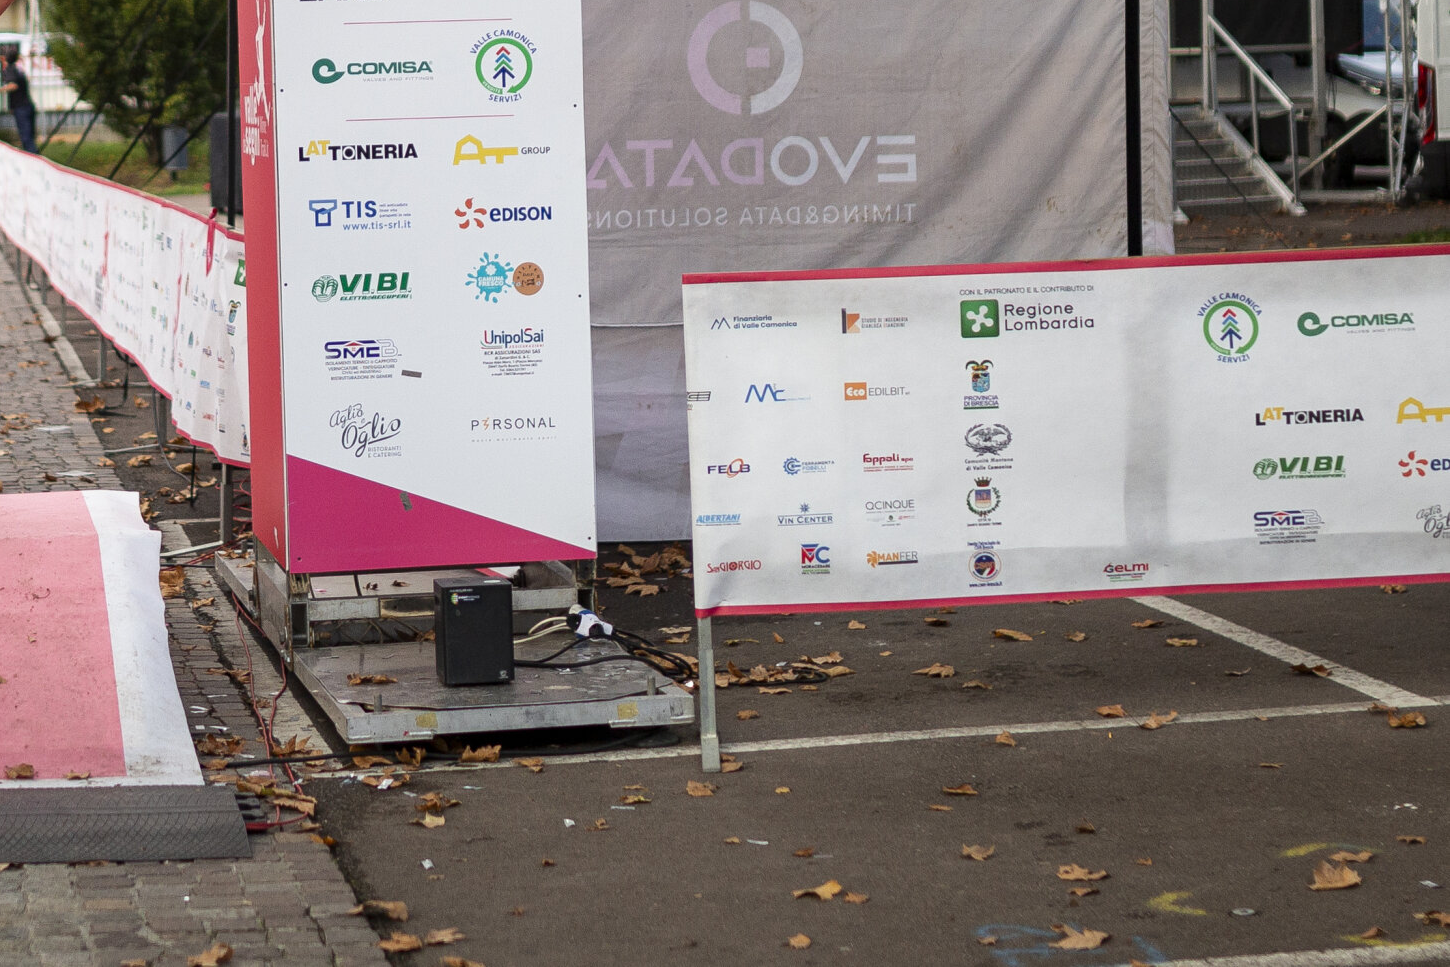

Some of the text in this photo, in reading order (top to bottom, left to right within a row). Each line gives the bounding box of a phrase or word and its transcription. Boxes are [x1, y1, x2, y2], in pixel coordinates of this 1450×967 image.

[470, 29, 537, 55] VALLE CAMONICA
[347, 61, 433, 74] COMISA
[489, 93, 522, 103] SERVIZI
[299, 140, 418, 162] LATTONERIA
[521, 146, 551, 155] GROUP
[342, 200, 377, 218] TIS
[343, 220, 411, 231] www.tis-srl.it
[1004, 303, 1074, 318] Regione
[1197, 292, 1262, 317] VALLE CAMONICA
[1005, 317, 1094, 331] Lombardia
[1331, 313, 1414, 327] COMISA
[484, 328, 544, 349] UnipolSai
[1216, 354, 1250, 363] SERVIZI
[868, 387, 905, 396] EDILBIT
[1256, 407, 1364, 425] LATTONERIA
[342, 413, 401, 458] Oglio
